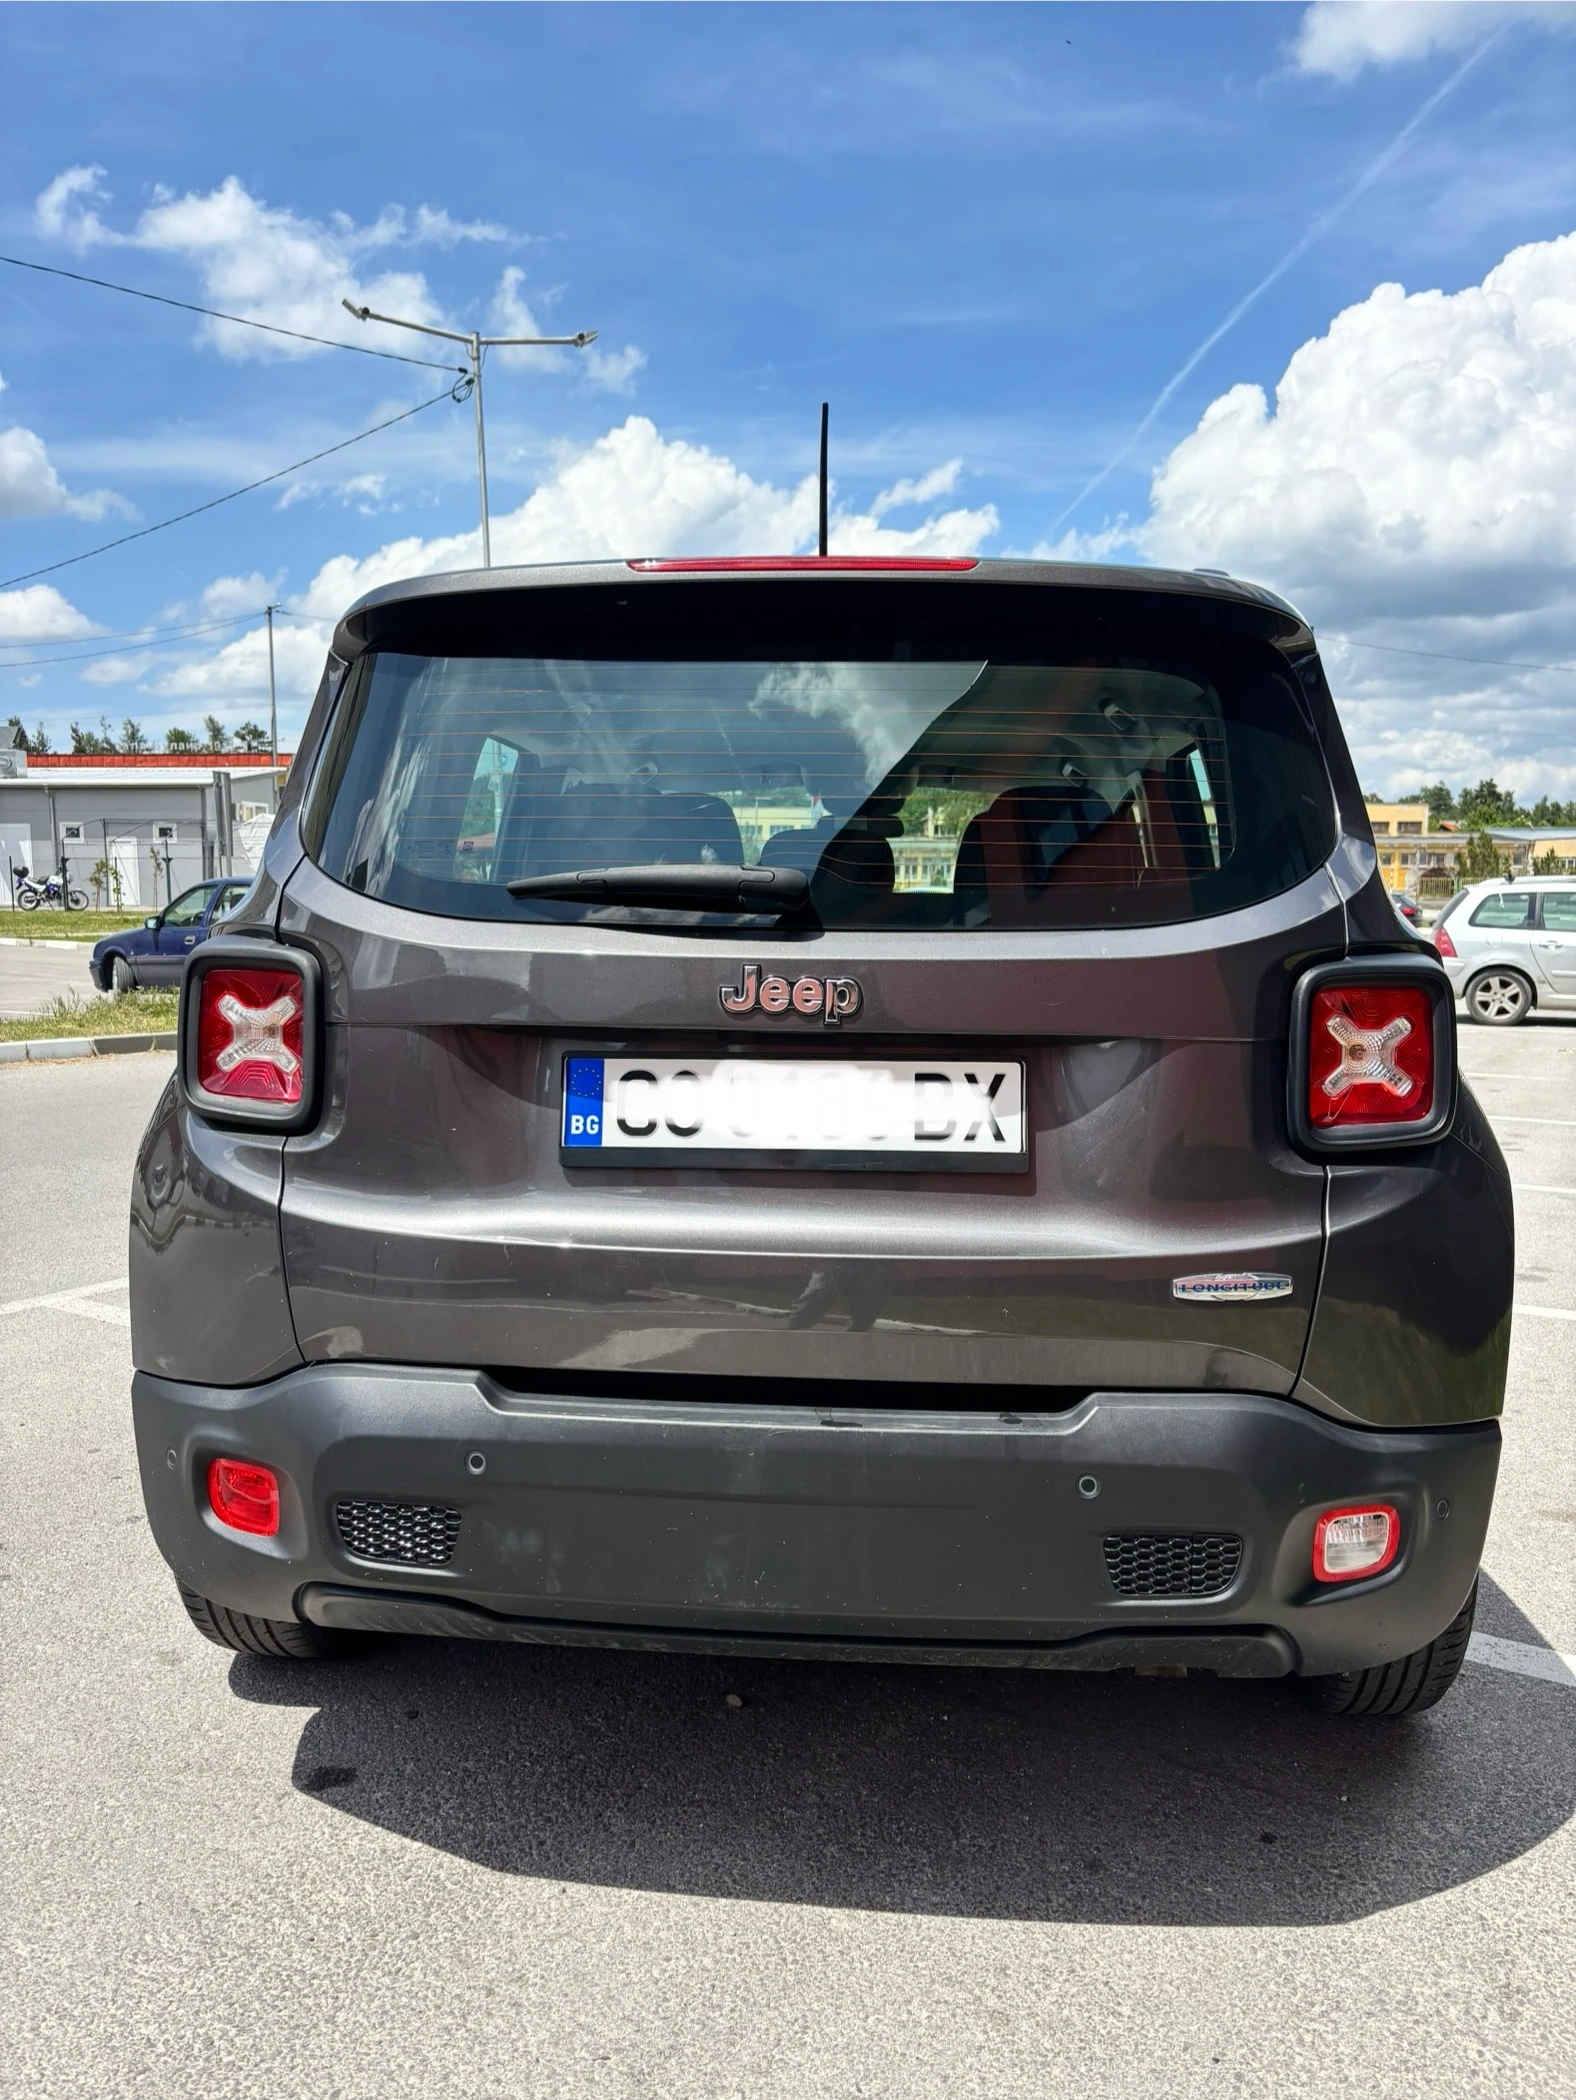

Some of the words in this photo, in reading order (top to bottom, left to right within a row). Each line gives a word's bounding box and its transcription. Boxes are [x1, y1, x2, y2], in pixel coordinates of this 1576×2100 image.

[719, 963, 864, 1025] Jeep
[571, 1114, 600, 1135] BG
[1178, 1281, 1288, 1293] LONGITUDE
